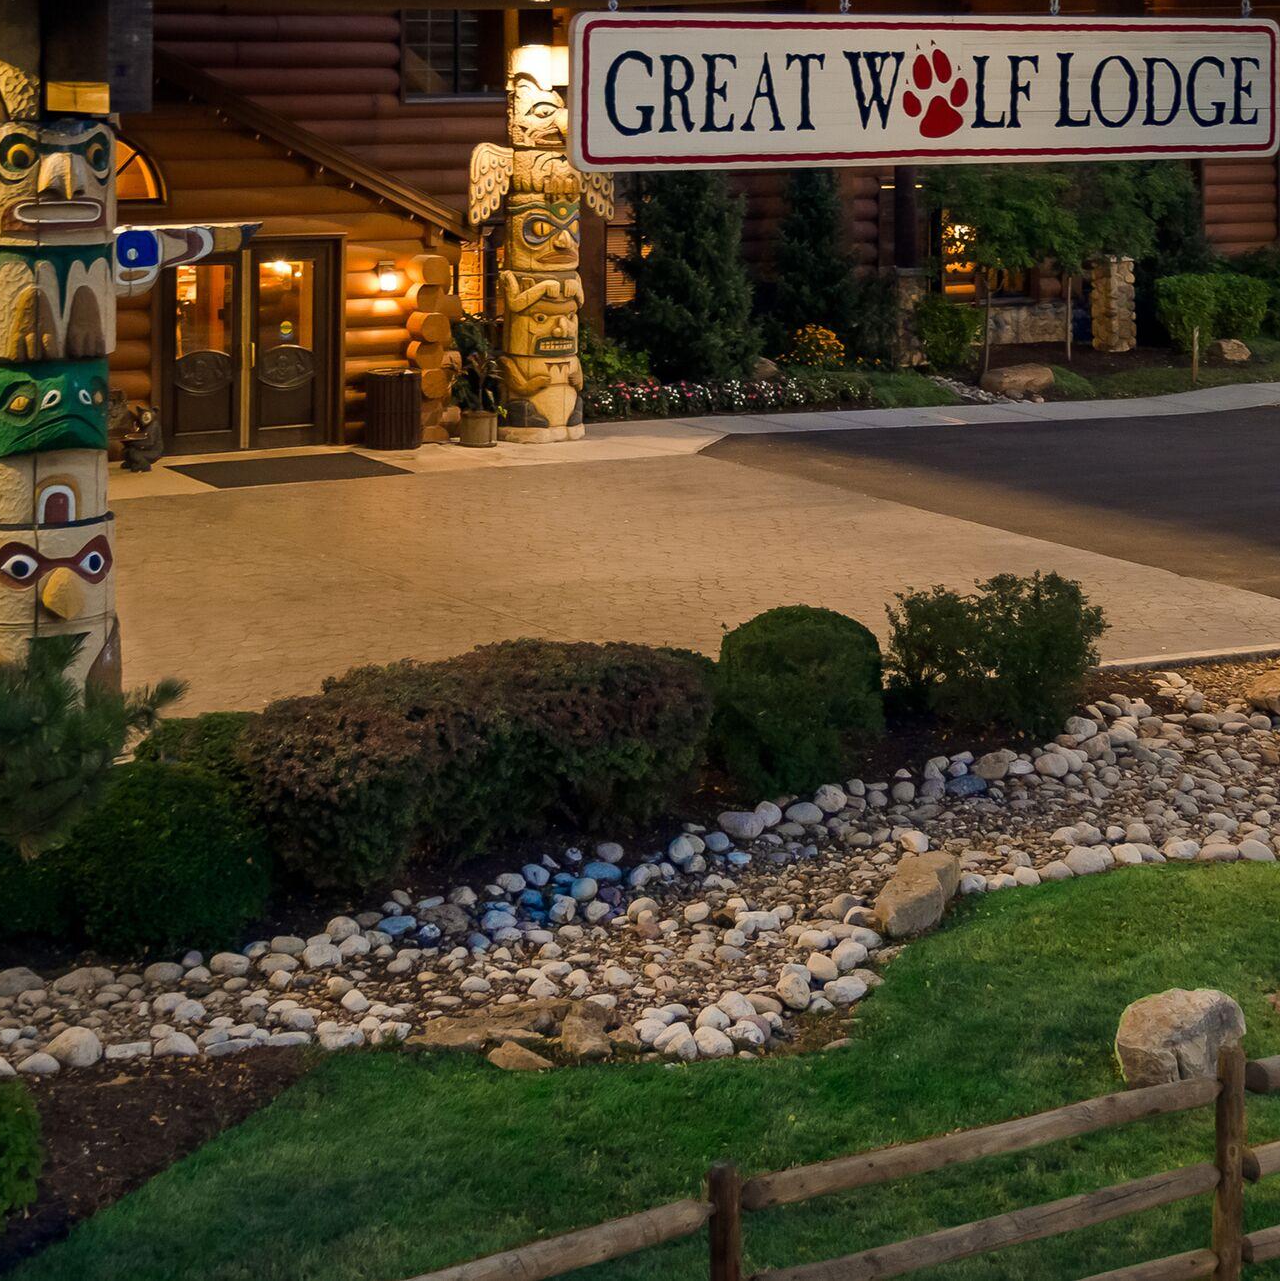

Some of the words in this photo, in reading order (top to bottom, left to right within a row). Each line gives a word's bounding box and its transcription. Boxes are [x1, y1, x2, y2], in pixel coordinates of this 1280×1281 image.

[604, 50, 826, 137] GREAT
[842, 47, 1040, 139] WLF
[1054, 52, 1262, 130] LODGE
